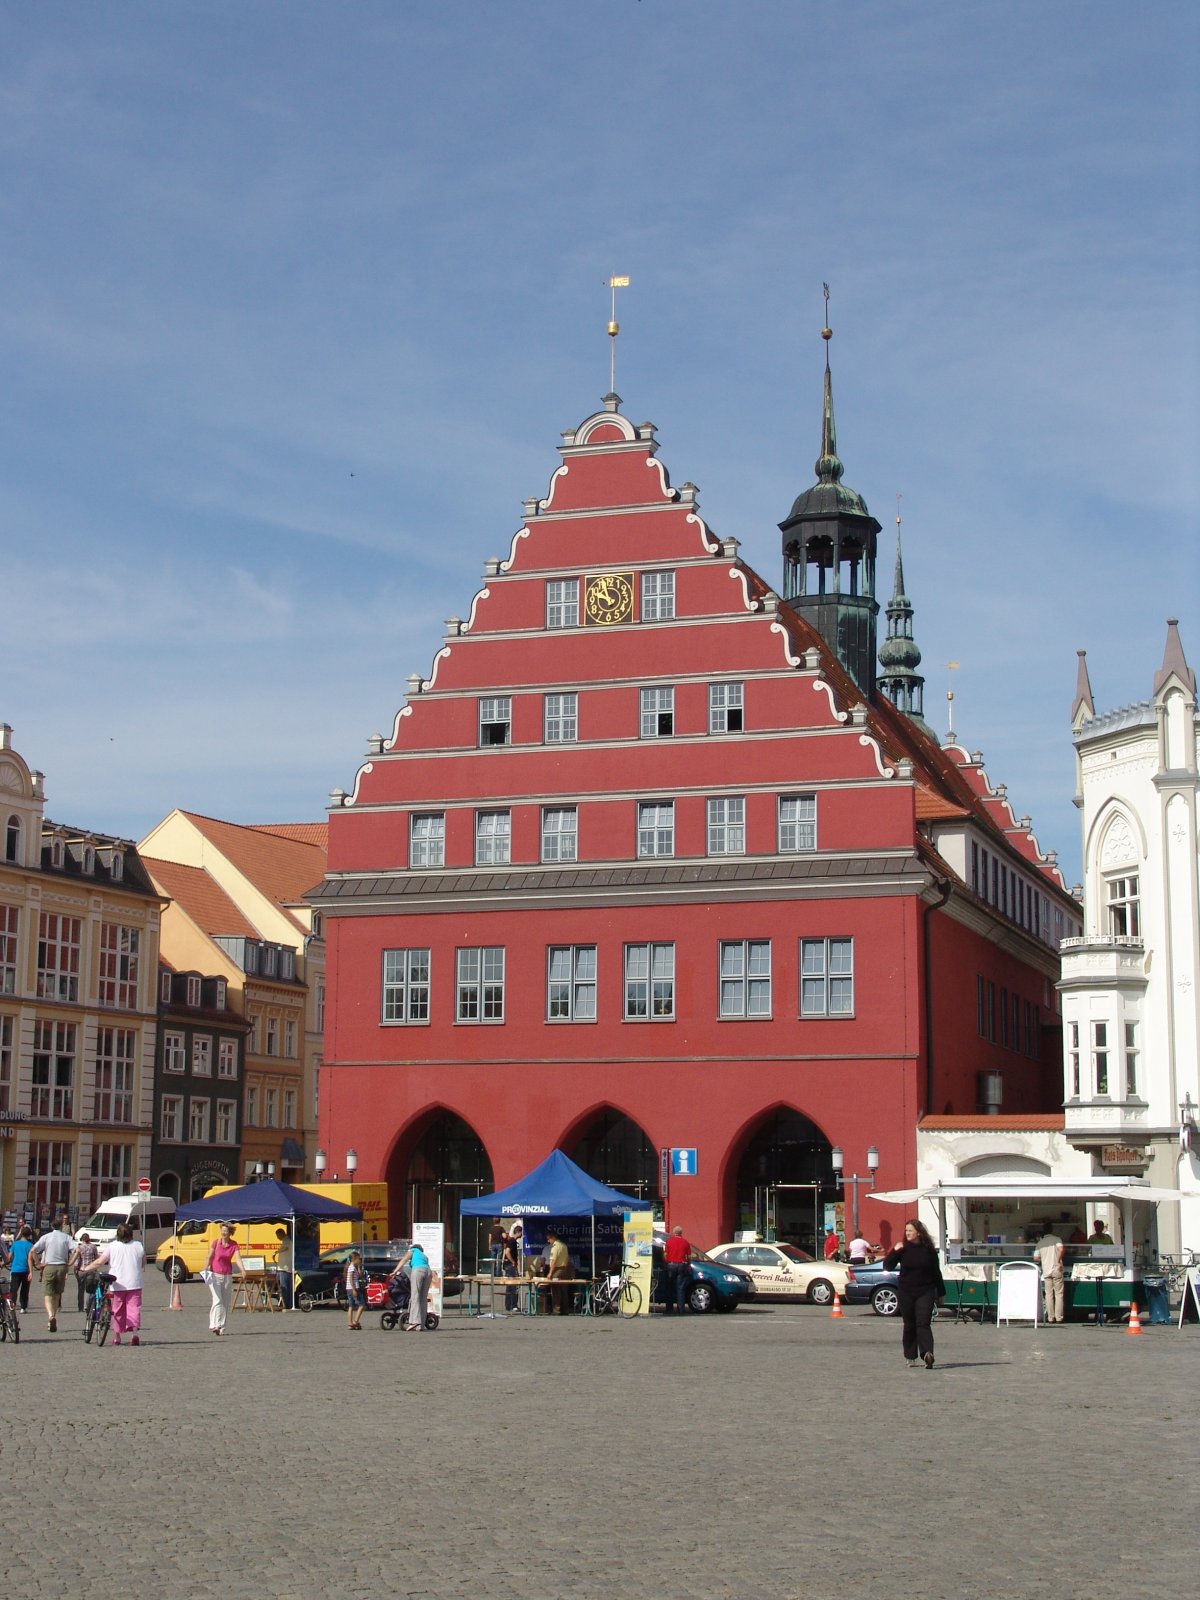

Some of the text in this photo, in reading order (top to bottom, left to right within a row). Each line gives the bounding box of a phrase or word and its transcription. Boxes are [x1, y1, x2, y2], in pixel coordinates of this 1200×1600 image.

[605, 577, 614, 587] 12
[591, 587, 599, 597] 10
[621, 584, 627, 594] 2
[589, 596, 595, 605] 9
[623, 594, 629, 604] 3
[591, 605, 597, 614] 8
[620, 603, 625, 612] 4
[597, 611, 603, 620] 7
[606, 612, 612, 621] 6
[614, 609, 620, 619] 5
[190, 1160, 230, 1176] AUGENOPTIK
[357, 1200, 382, 1212] DHL
[501, 1203, 551, 1216] PROVINZIAL
[774, 1274, 794, 1284] Bahls
